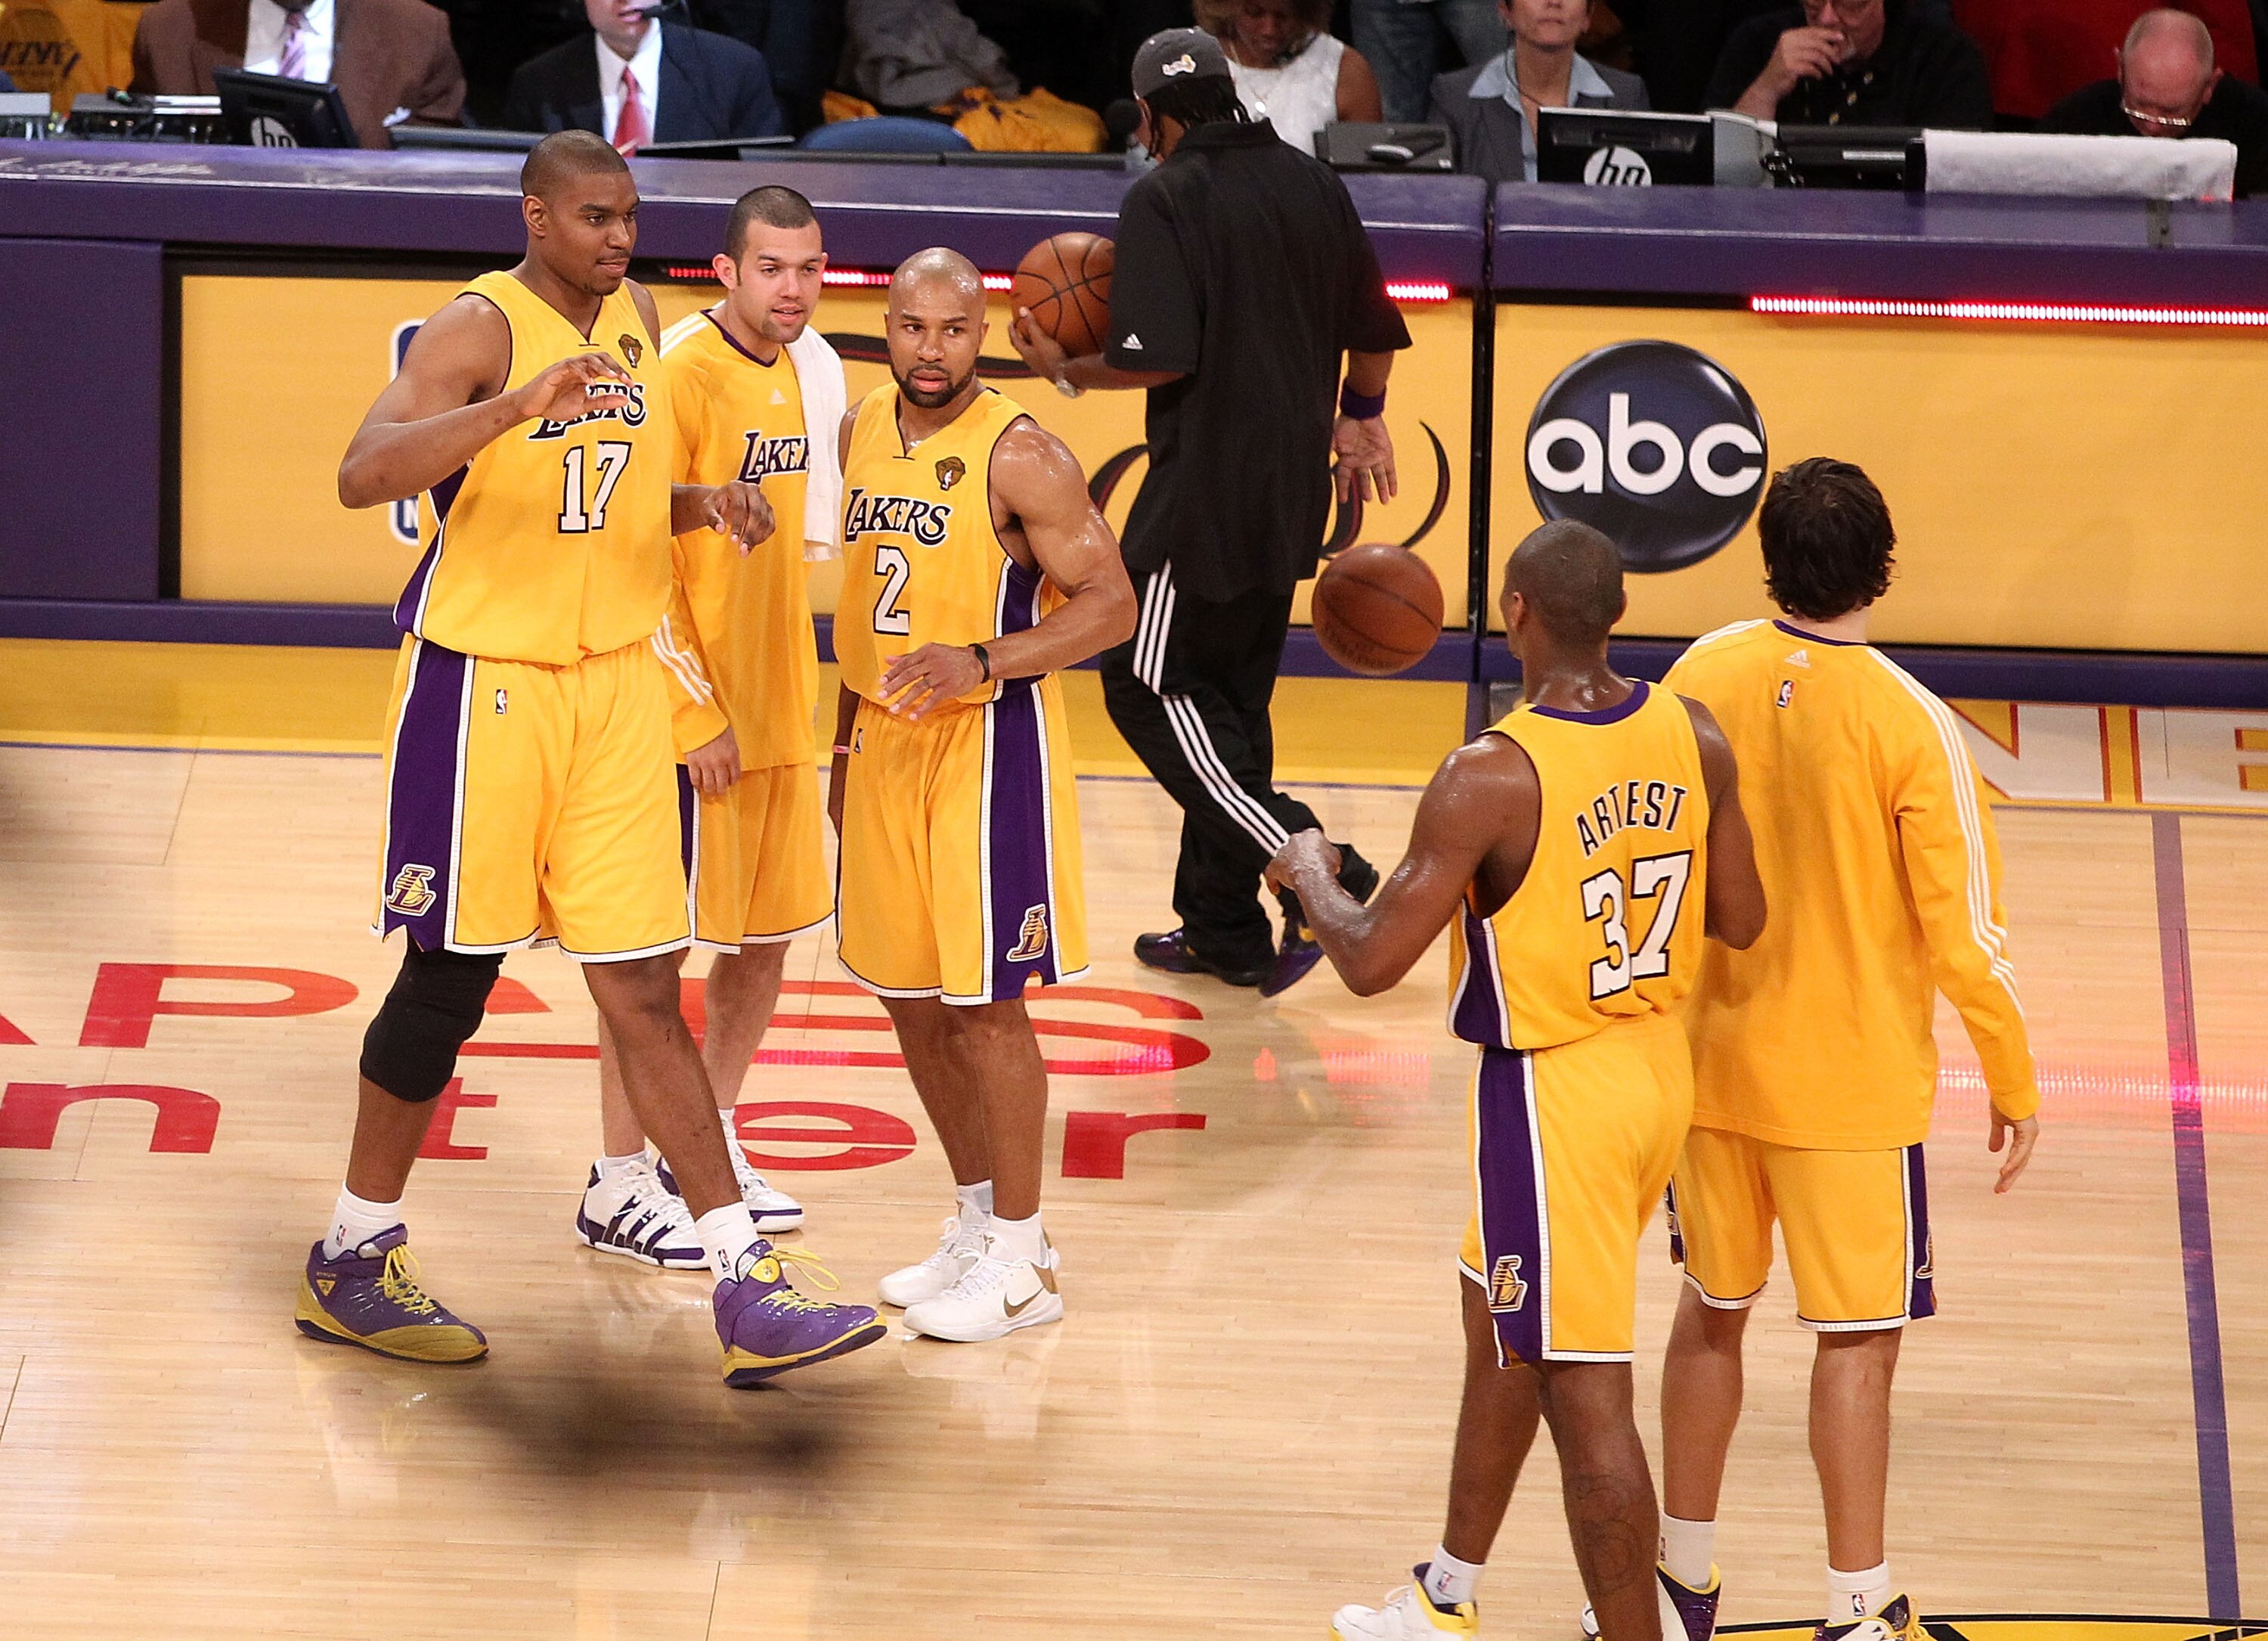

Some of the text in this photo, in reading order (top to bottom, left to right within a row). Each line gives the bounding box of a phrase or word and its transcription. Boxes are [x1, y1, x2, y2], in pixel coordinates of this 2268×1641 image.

[557, 439, 634, 534] 17
[1528, 392, 1763, 497] abc
[844, 487, 953, 548] LAKERS
[872, 544, 911, 637] 2
[1576, 779, 1688, 859] ARTEST
[1580, 848, 1694, 1001] 37
